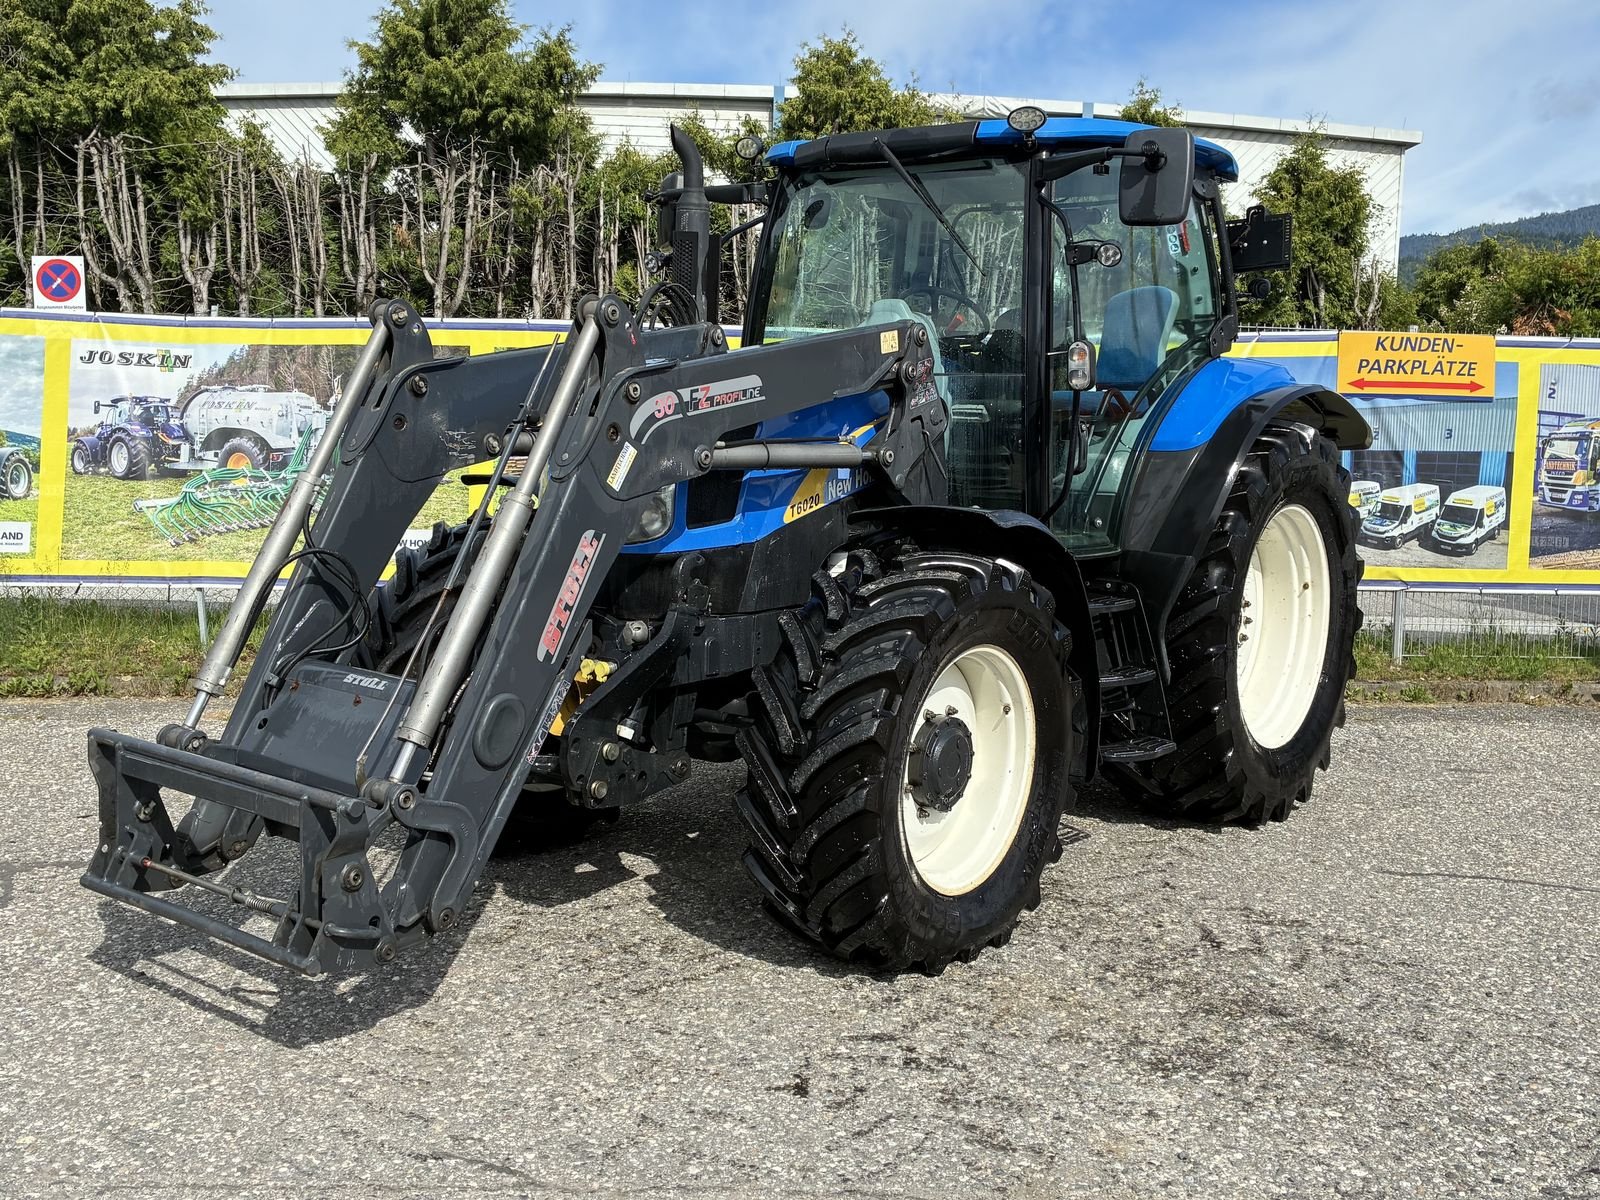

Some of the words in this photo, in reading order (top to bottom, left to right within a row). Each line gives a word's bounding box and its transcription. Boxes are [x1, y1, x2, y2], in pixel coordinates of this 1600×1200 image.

[1375, 336, 1464, 353] KUNDEN-
[80, 349, 192, 369] JOSKIN
[1357, 355, 1478, 377] PARKPLÄTZE
[654, 395, 676, 419] 30
[688, 386, 711, 412] FZ
[828, 477, 852, 501] New
[790, 493, 820, 518] T6020
[543, 536, 600, 656] STOLL
[343, 673, 389, 691] STOLL
